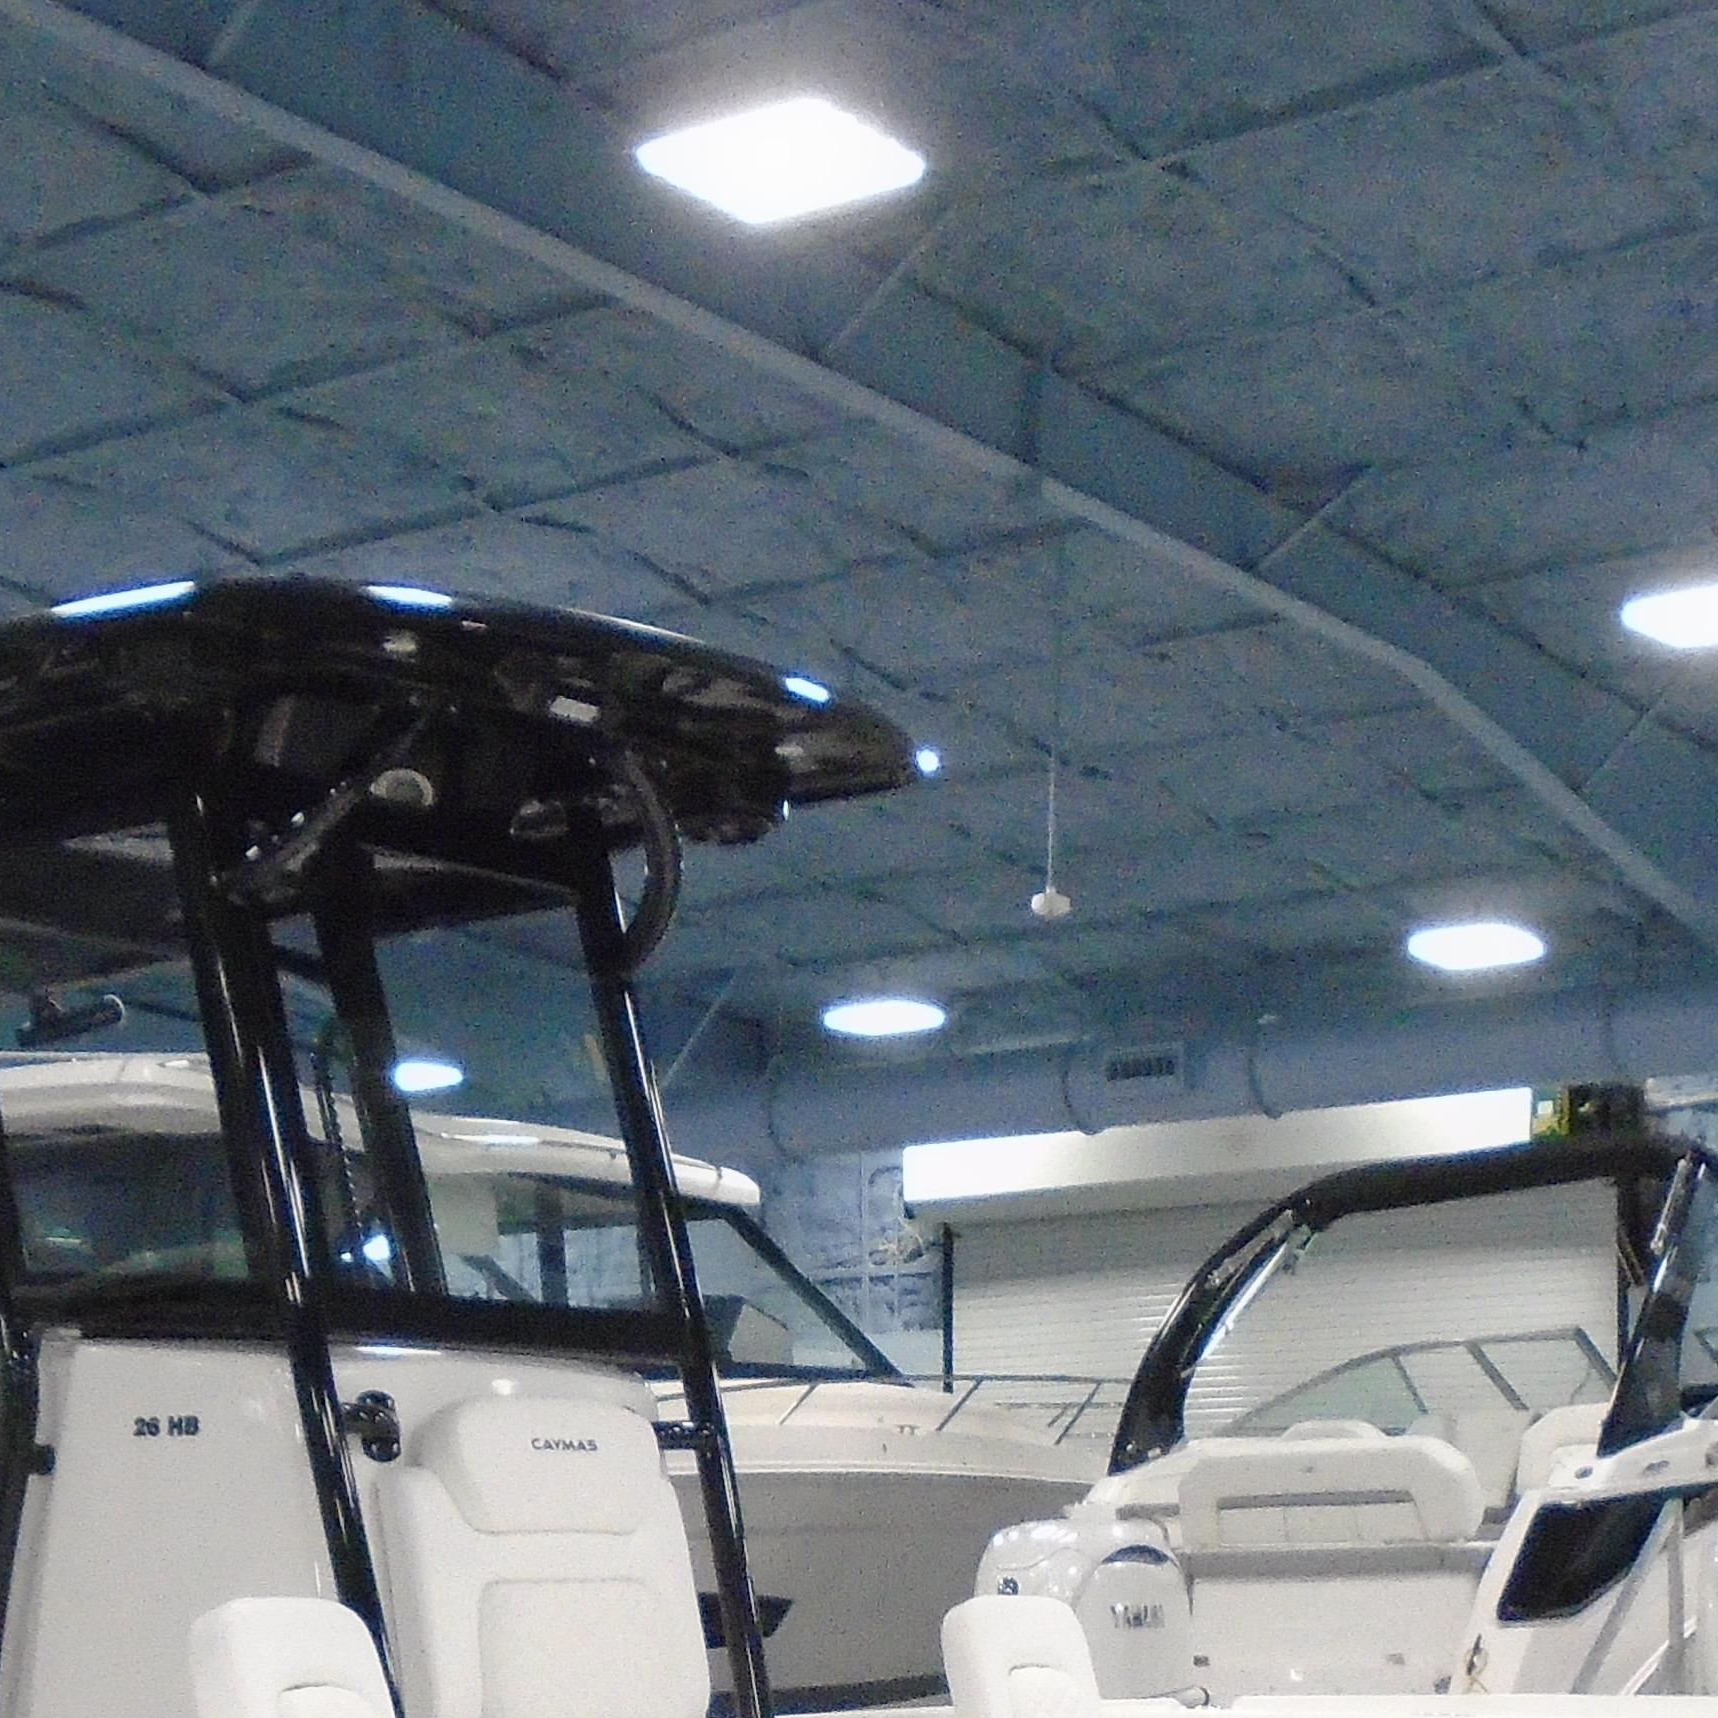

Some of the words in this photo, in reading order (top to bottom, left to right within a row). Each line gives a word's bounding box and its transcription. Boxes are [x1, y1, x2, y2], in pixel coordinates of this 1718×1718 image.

[132, 1416, 161, 1437] 26
[168, 1415, 199, 1436] HB
[530, 1437, 599, 1452] CAYMAS
